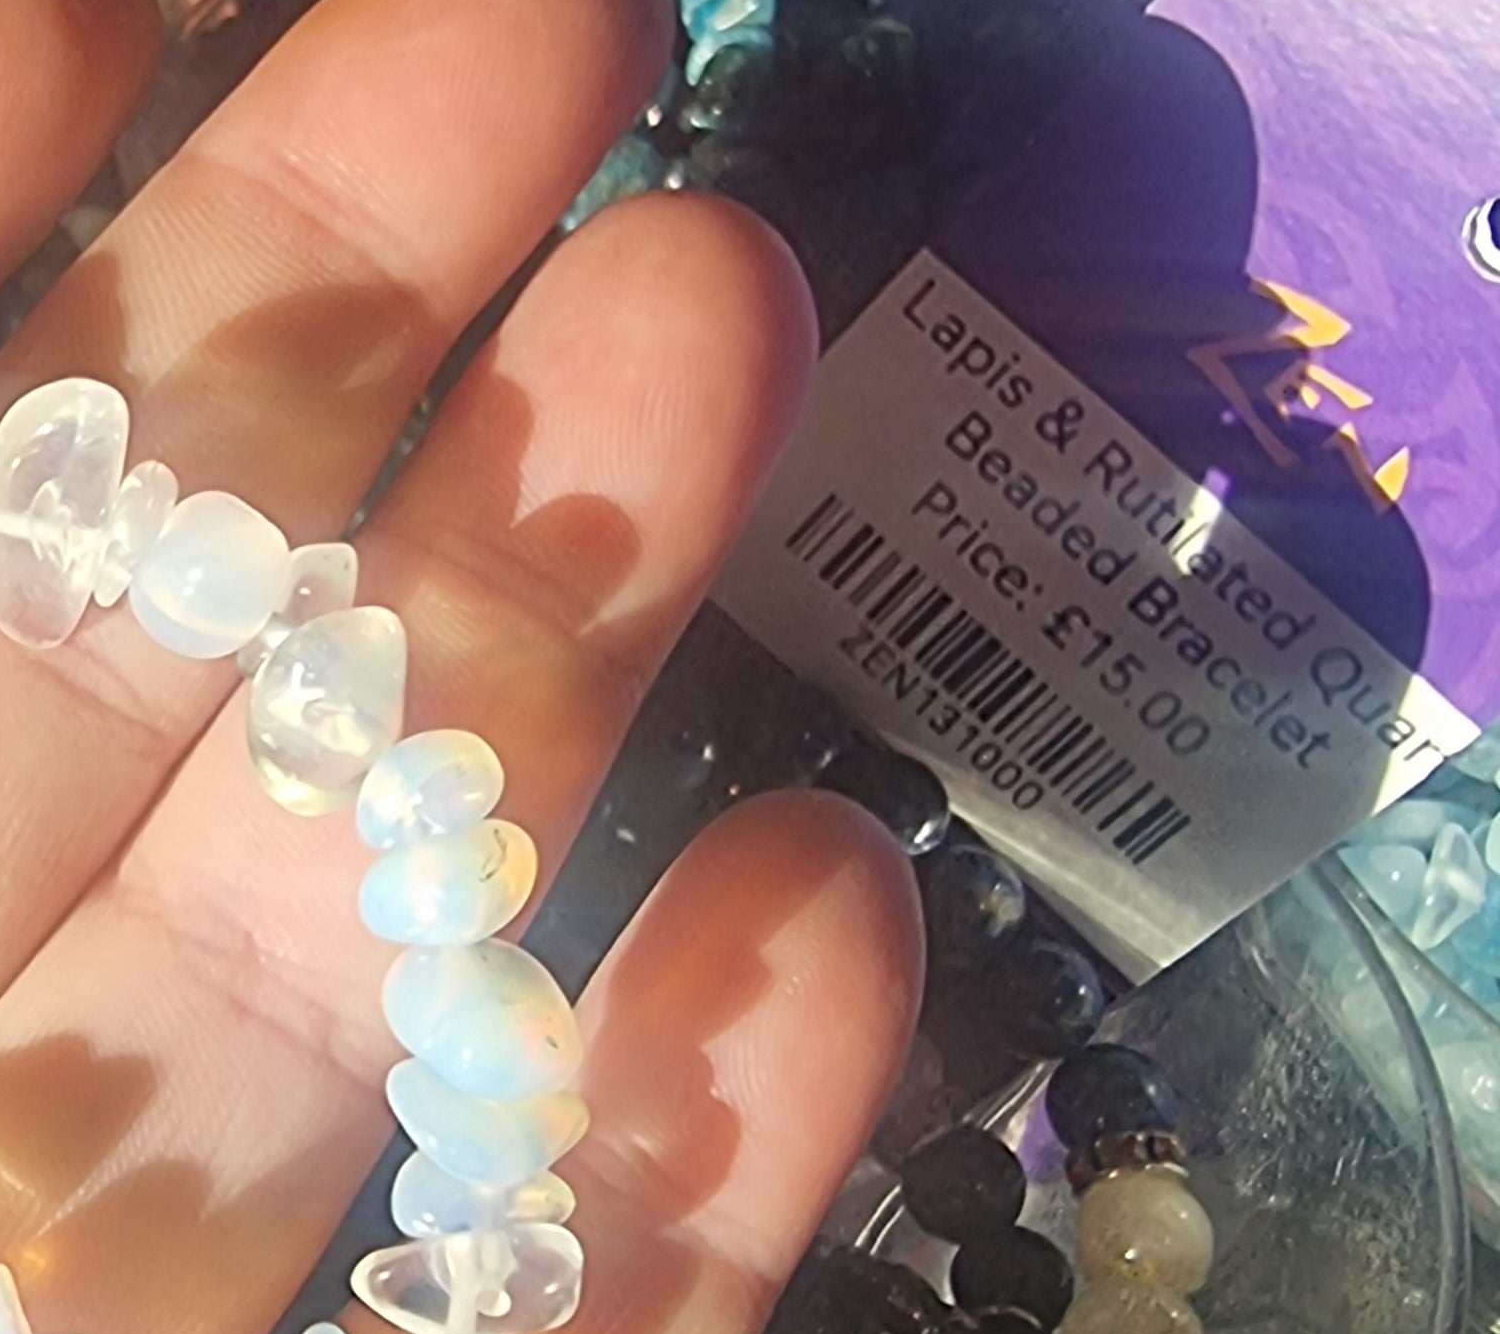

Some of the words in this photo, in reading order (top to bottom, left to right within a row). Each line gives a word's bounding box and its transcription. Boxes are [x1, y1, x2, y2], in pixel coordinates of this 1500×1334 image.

[902, 277, 1034, 410] Lapis
[1034, 398, 1086, 456] &
[1082, 437, 1318, 650] Rutilated
[1309, 645, 1450, 763] Quar
[1185, 277, 1411, 516] ZEN
[836, 624, 1046, 813] ZEN131000
[911, 479, 1044, 613] Price:
[1040, 604, 1212, 758] £15.00
[944, 409, 1138, 586] Beaded
[1127, 575, 1332, 770] Bracelet
